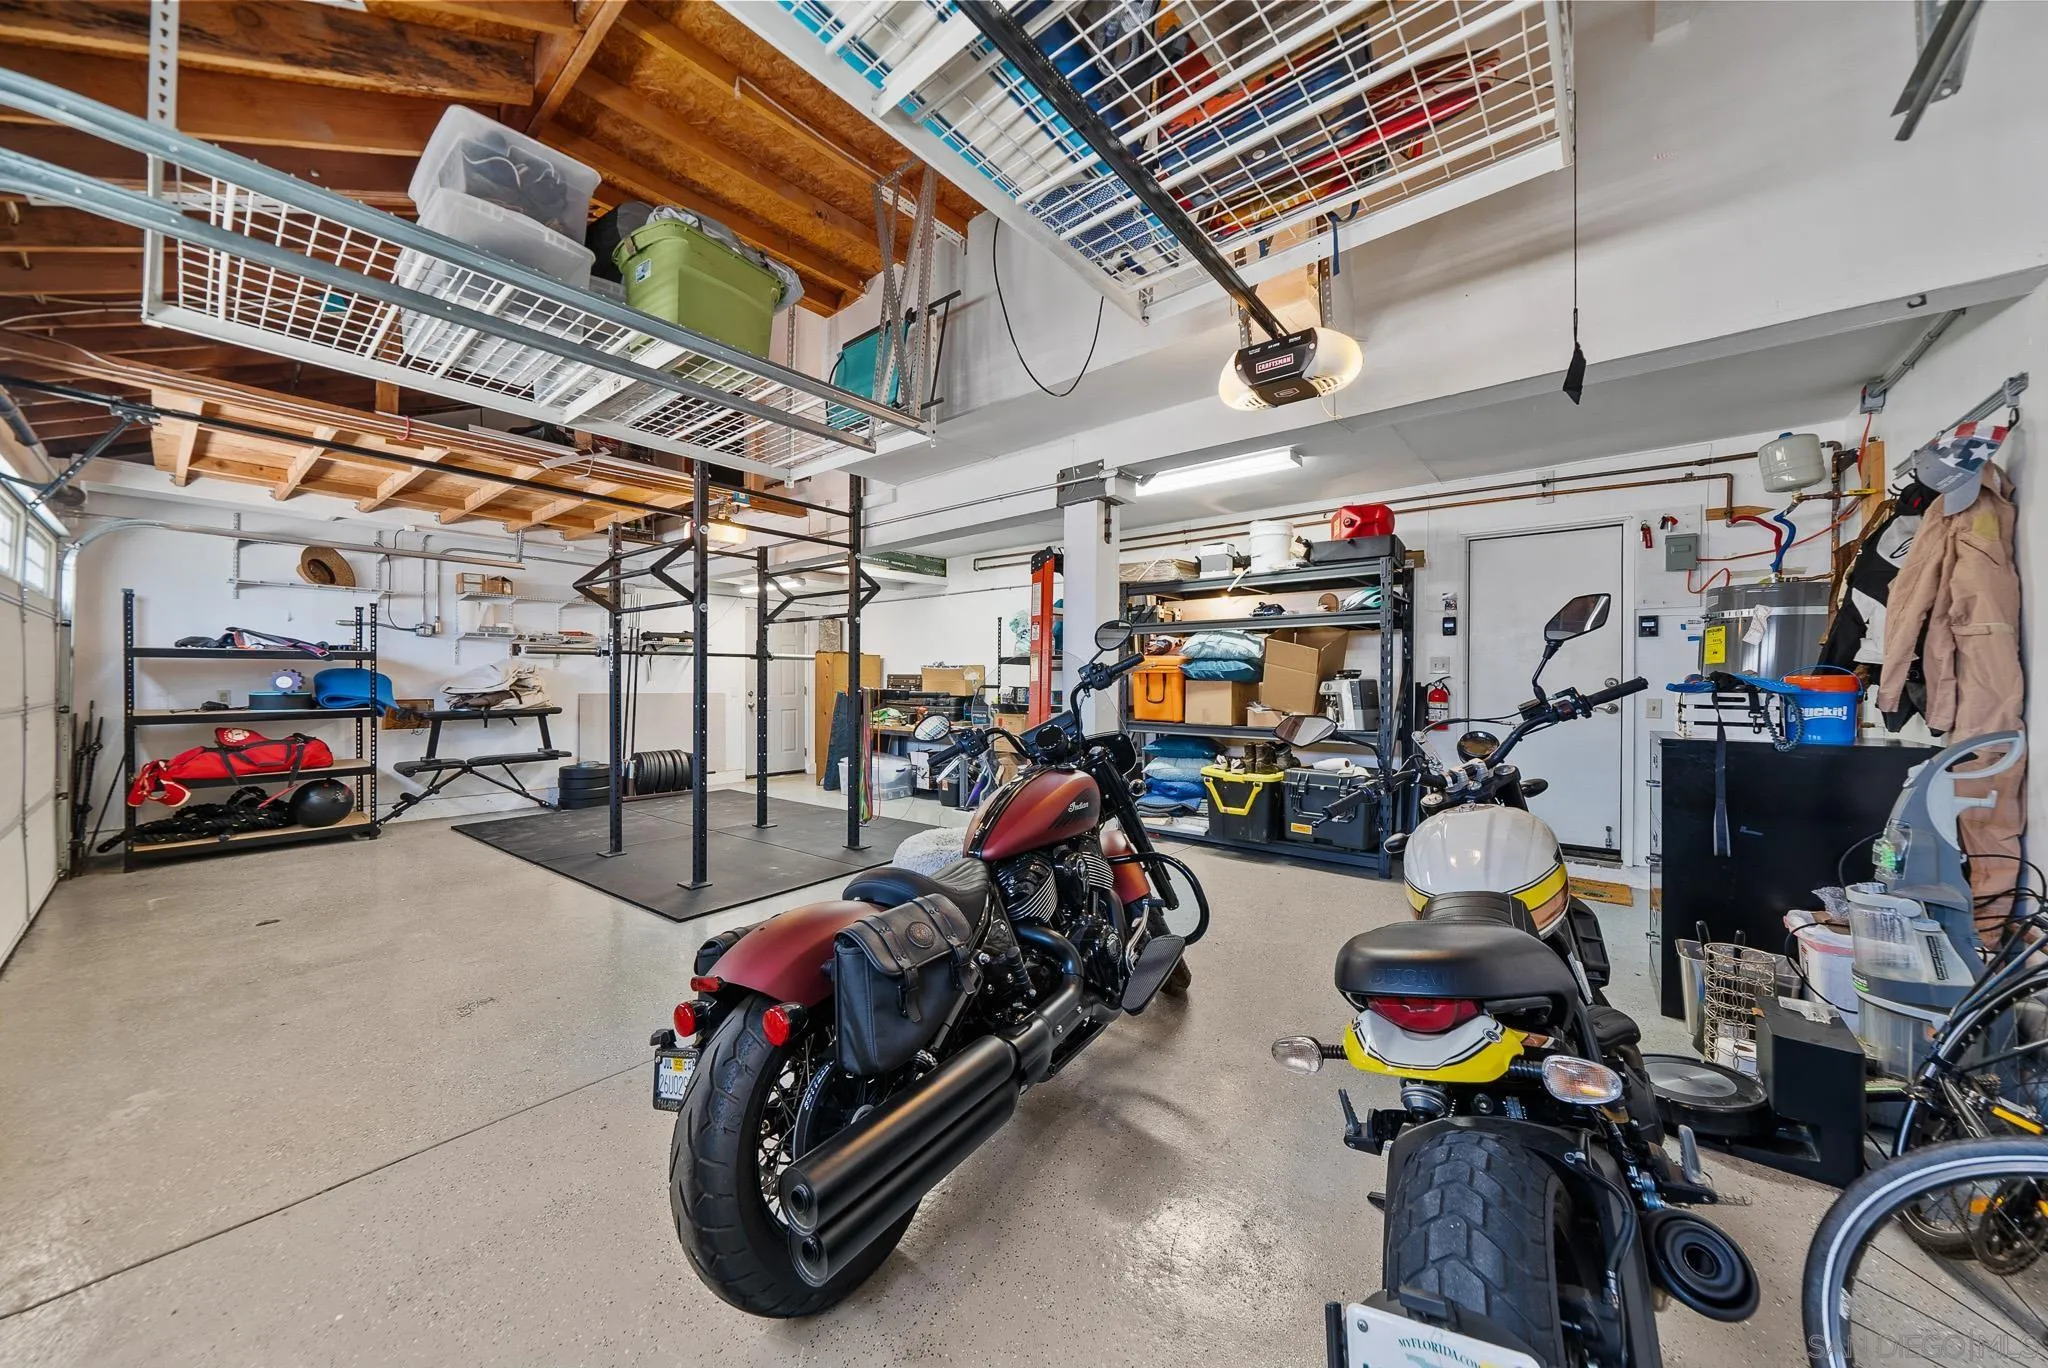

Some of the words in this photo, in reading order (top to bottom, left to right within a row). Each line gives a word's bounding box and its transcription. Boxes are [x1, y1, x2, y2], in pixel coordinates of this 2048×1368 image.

[1258, 356, 1292, 371] CRAFTSMAN
[1788, 705, 1848, 722] Cuckit!
[1068, 801, 1089, 812] Indian
